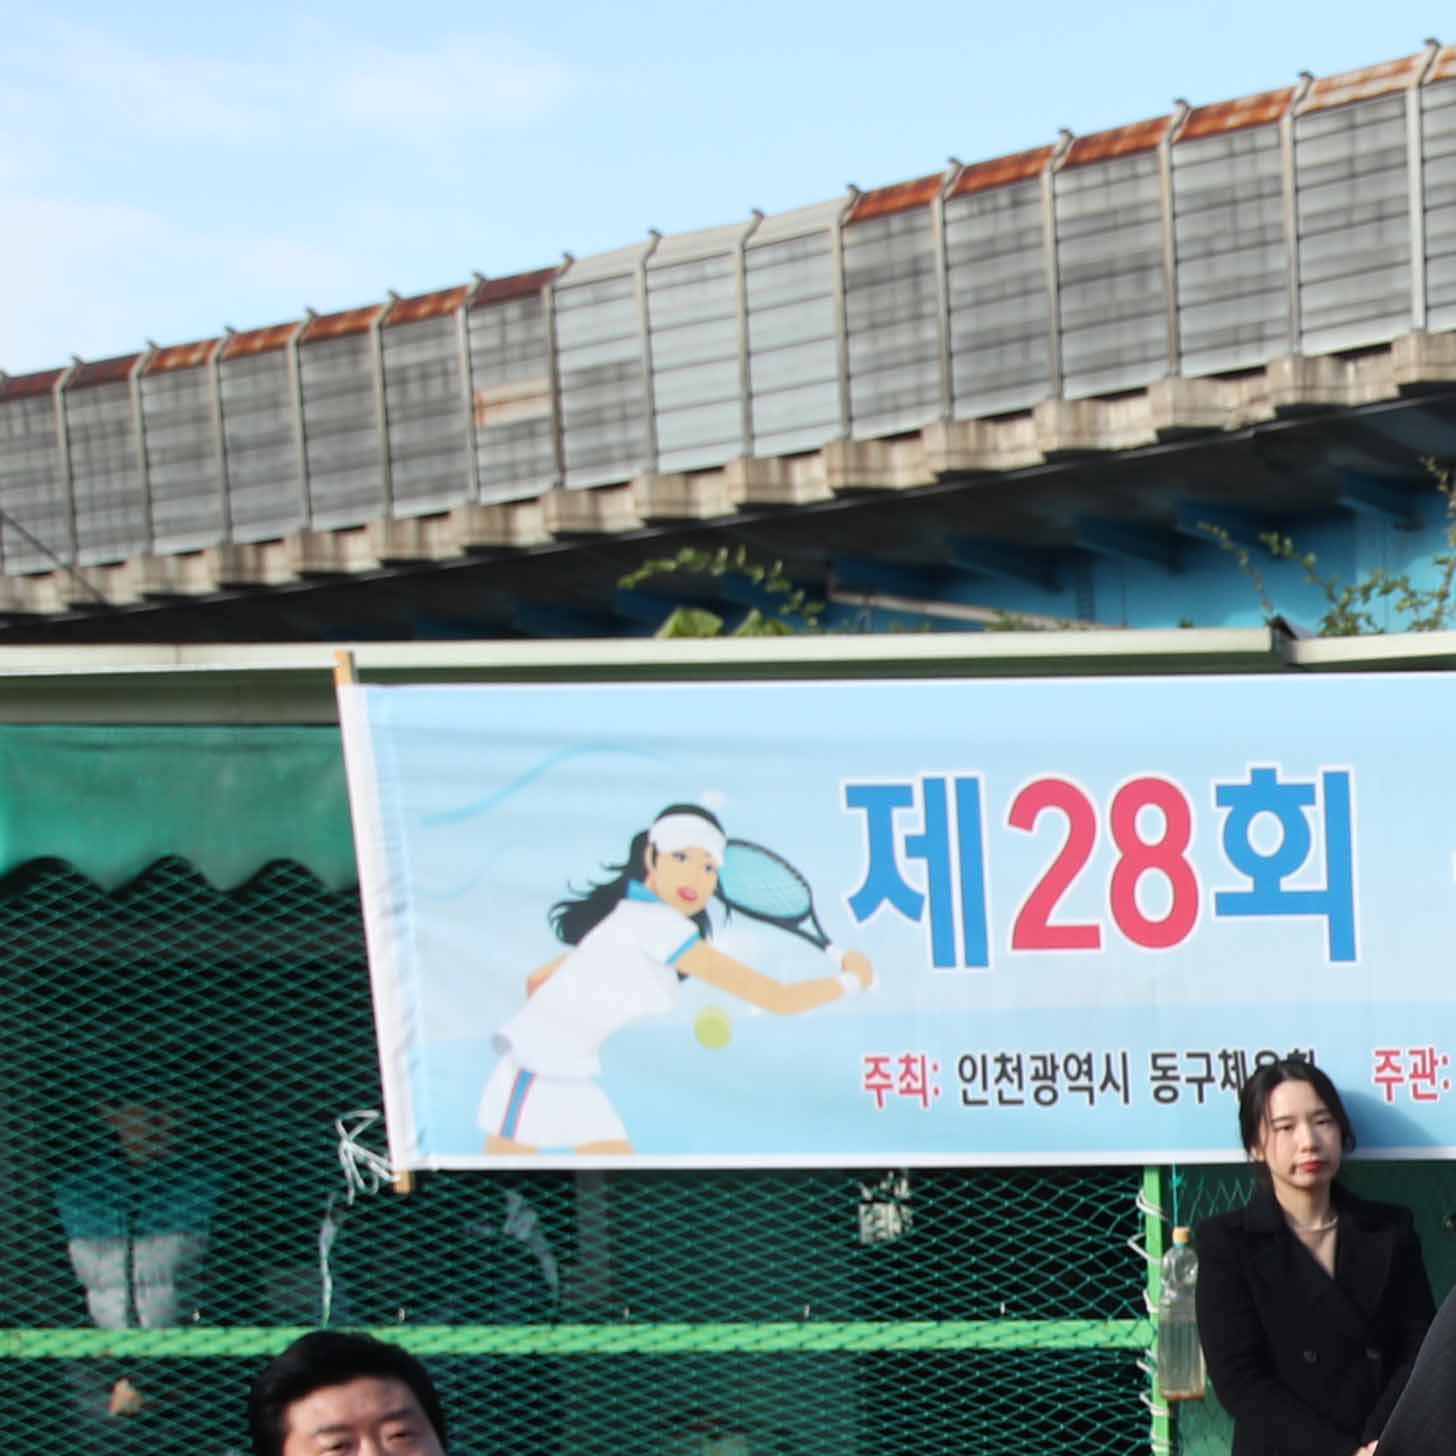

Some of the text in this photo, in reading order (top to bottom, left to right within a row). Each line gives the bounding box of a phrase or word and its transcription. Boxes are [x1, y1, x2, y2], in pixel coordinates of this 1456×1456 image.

[845, 765, 1358, 969] 제28회
[863, 1053, 940, 1107] 주최:
[957, 1051, 1131, 1105] 인천광역시
[1149, 1048, 1316, 1104] 동구체
[1373, 1048, 1450, 1101] 주관:
